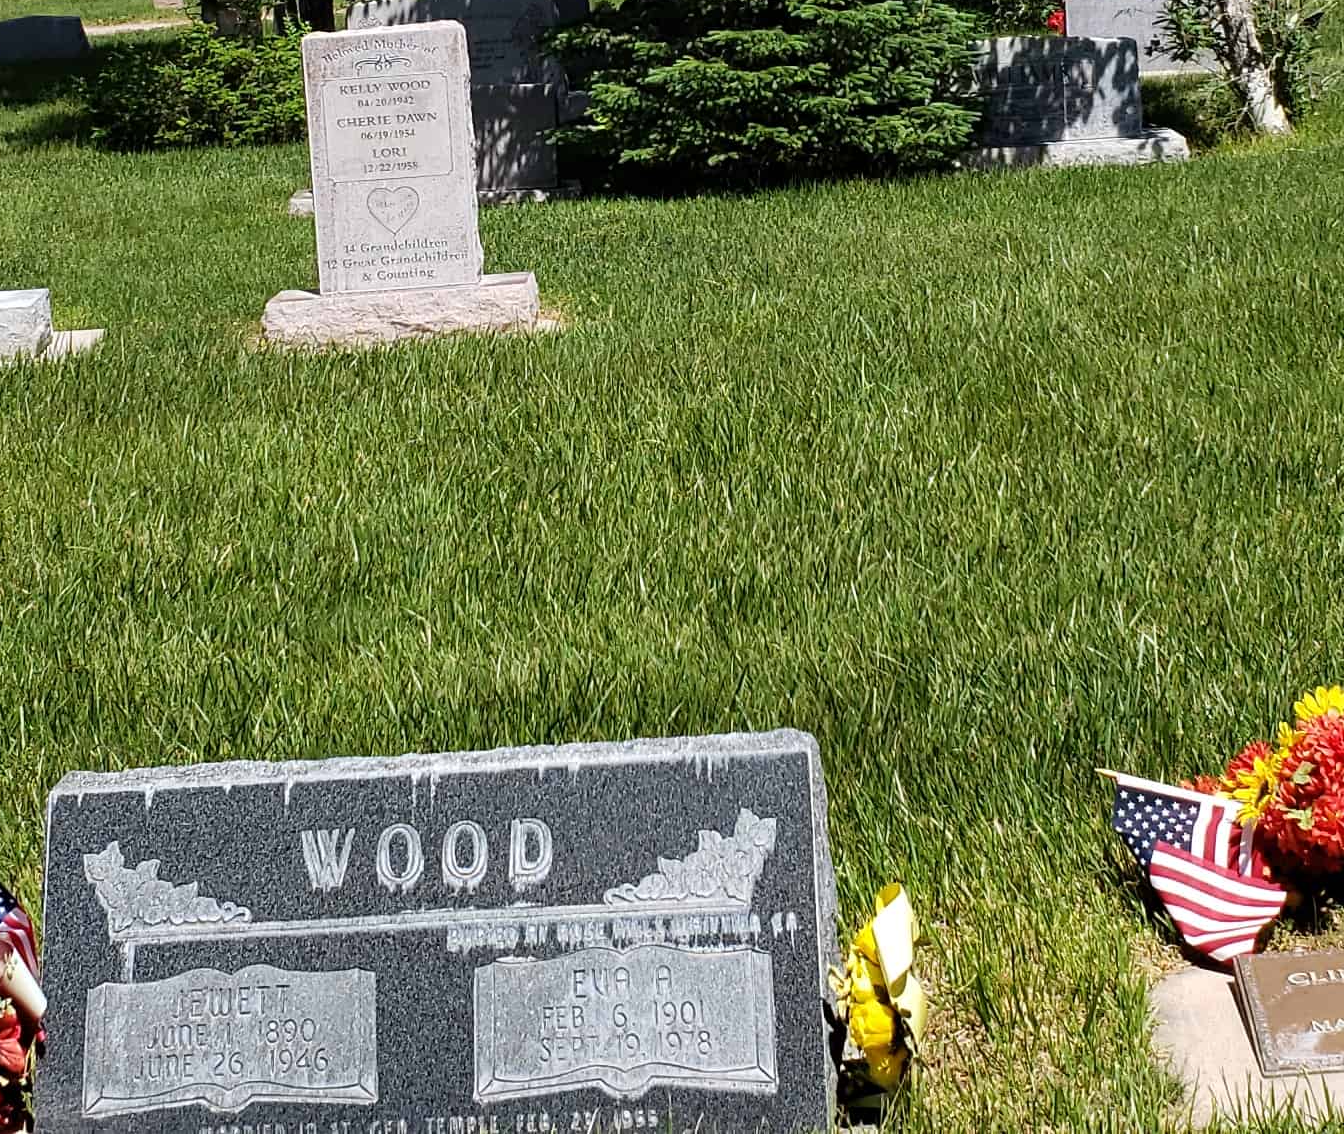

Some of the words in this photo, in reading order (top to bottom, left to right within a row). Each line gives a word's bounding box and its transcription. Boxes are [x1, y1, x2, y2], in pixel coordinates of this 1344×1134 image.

[321, 39, 369, 64] Beloved
[339, 83, 382, 96] KELLY
[387, 79, 431, 92] WOOD
[357, 95, 416, 108] 04/20/1942
[336, 114, 392, 128] CHERIE
[396, 111, 438, 124] DAWN
[372, 147, 408, 159] LORI
[360, 237, 449, 254] Grandchildren
[342, 256, 376, 269] Great
[380, 249, 469, 266] Grandchildren
[362, 272, 372, 282] &
[376, 267, 436, 282] Counting
[301, 818, 553, 888] WOOD
[574, 967, 630, 998] EVA
[656, 965, 672, 995] A
[172, 984, 290, 1018] JEWETT
[655, 999, 703, 1026] 1901
[147, 1023, 208, 1050] JUNE
[257, 1017, 316, 1044] 1890
[658, 1030, 712, 1057] 1978
[134, 1053, 194, 1080] JUNE
[269, 1047, 330, 1075] 1946
